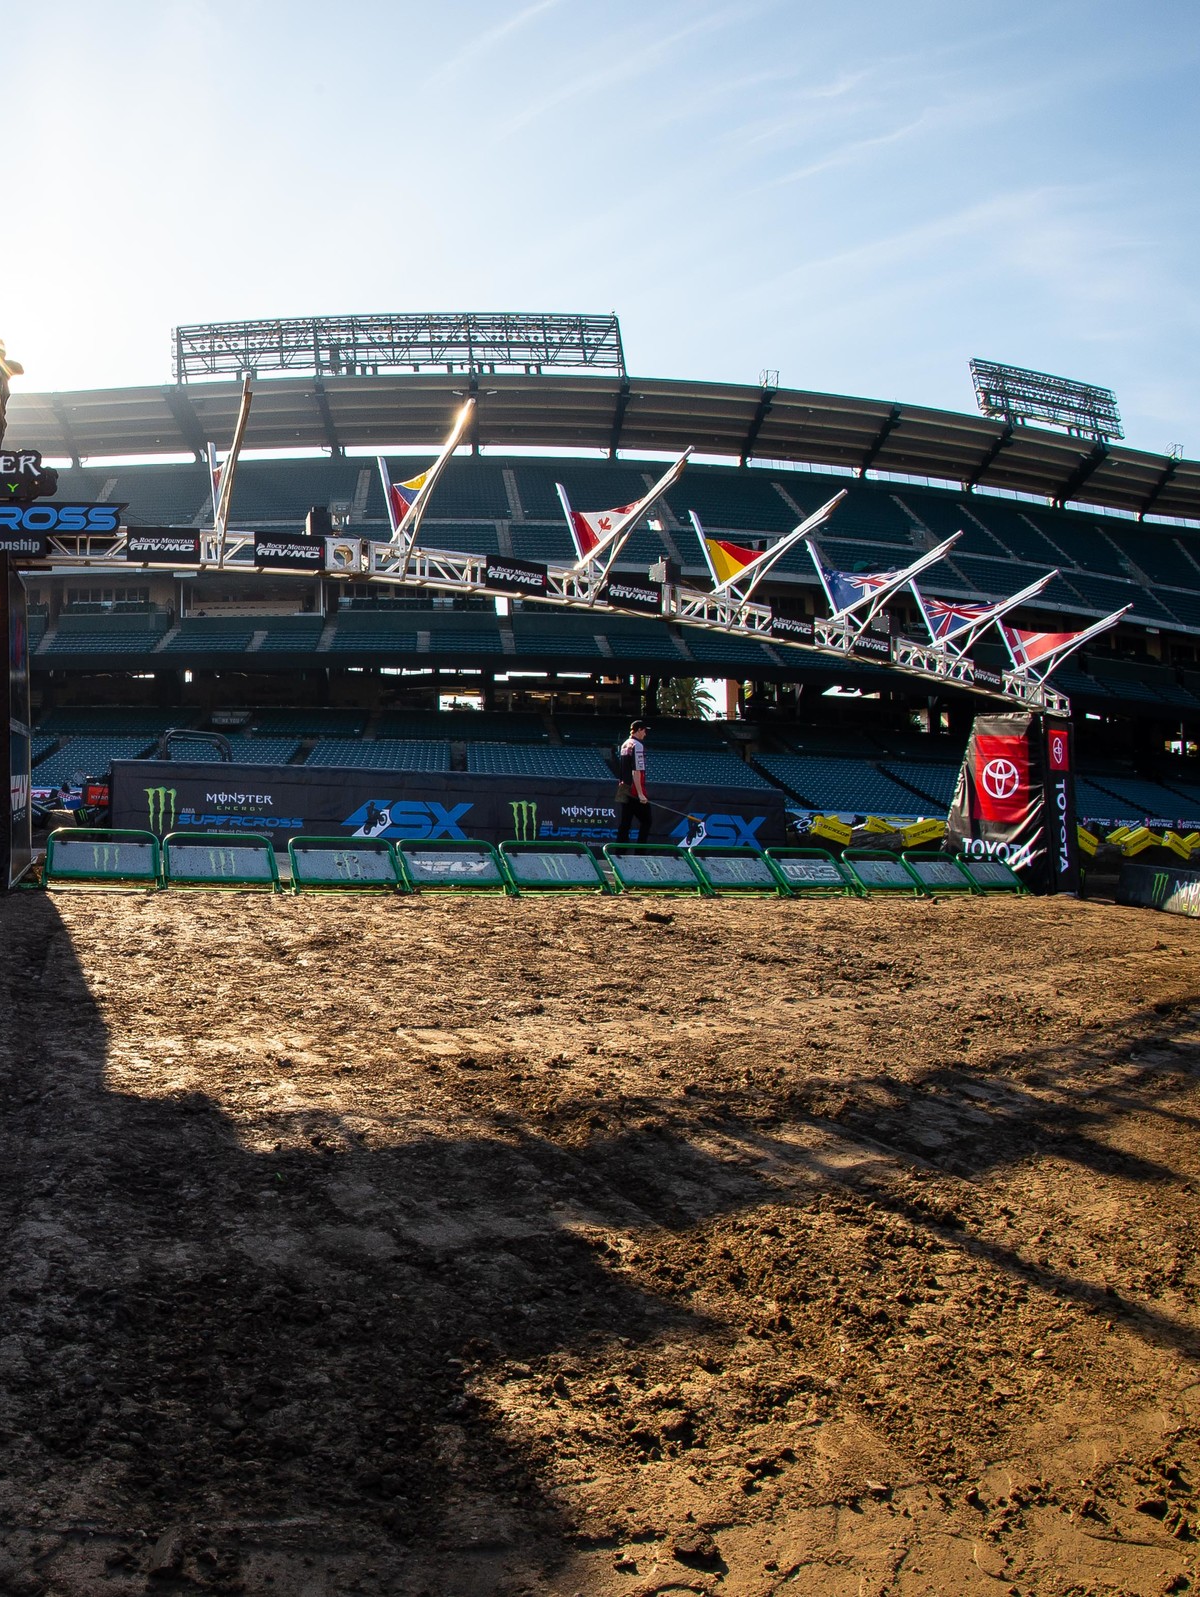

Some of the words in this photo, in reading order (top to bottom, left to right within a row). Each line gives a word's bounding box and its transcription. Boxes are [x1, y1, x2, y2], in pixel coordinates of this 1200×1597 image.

[206, 792, 273, 806] MONSTER
[561, 805, 616, 818] MONSTER
[177, 814, 304, 828] SUPERCROSS
[1055, 778, 1069, 873] TOYOTA
[823, 824, 850, 838] DUNLOP
[912, 826, 938, 839] DUNLOP
[962, 837, 1033, 867] TOYOTA
